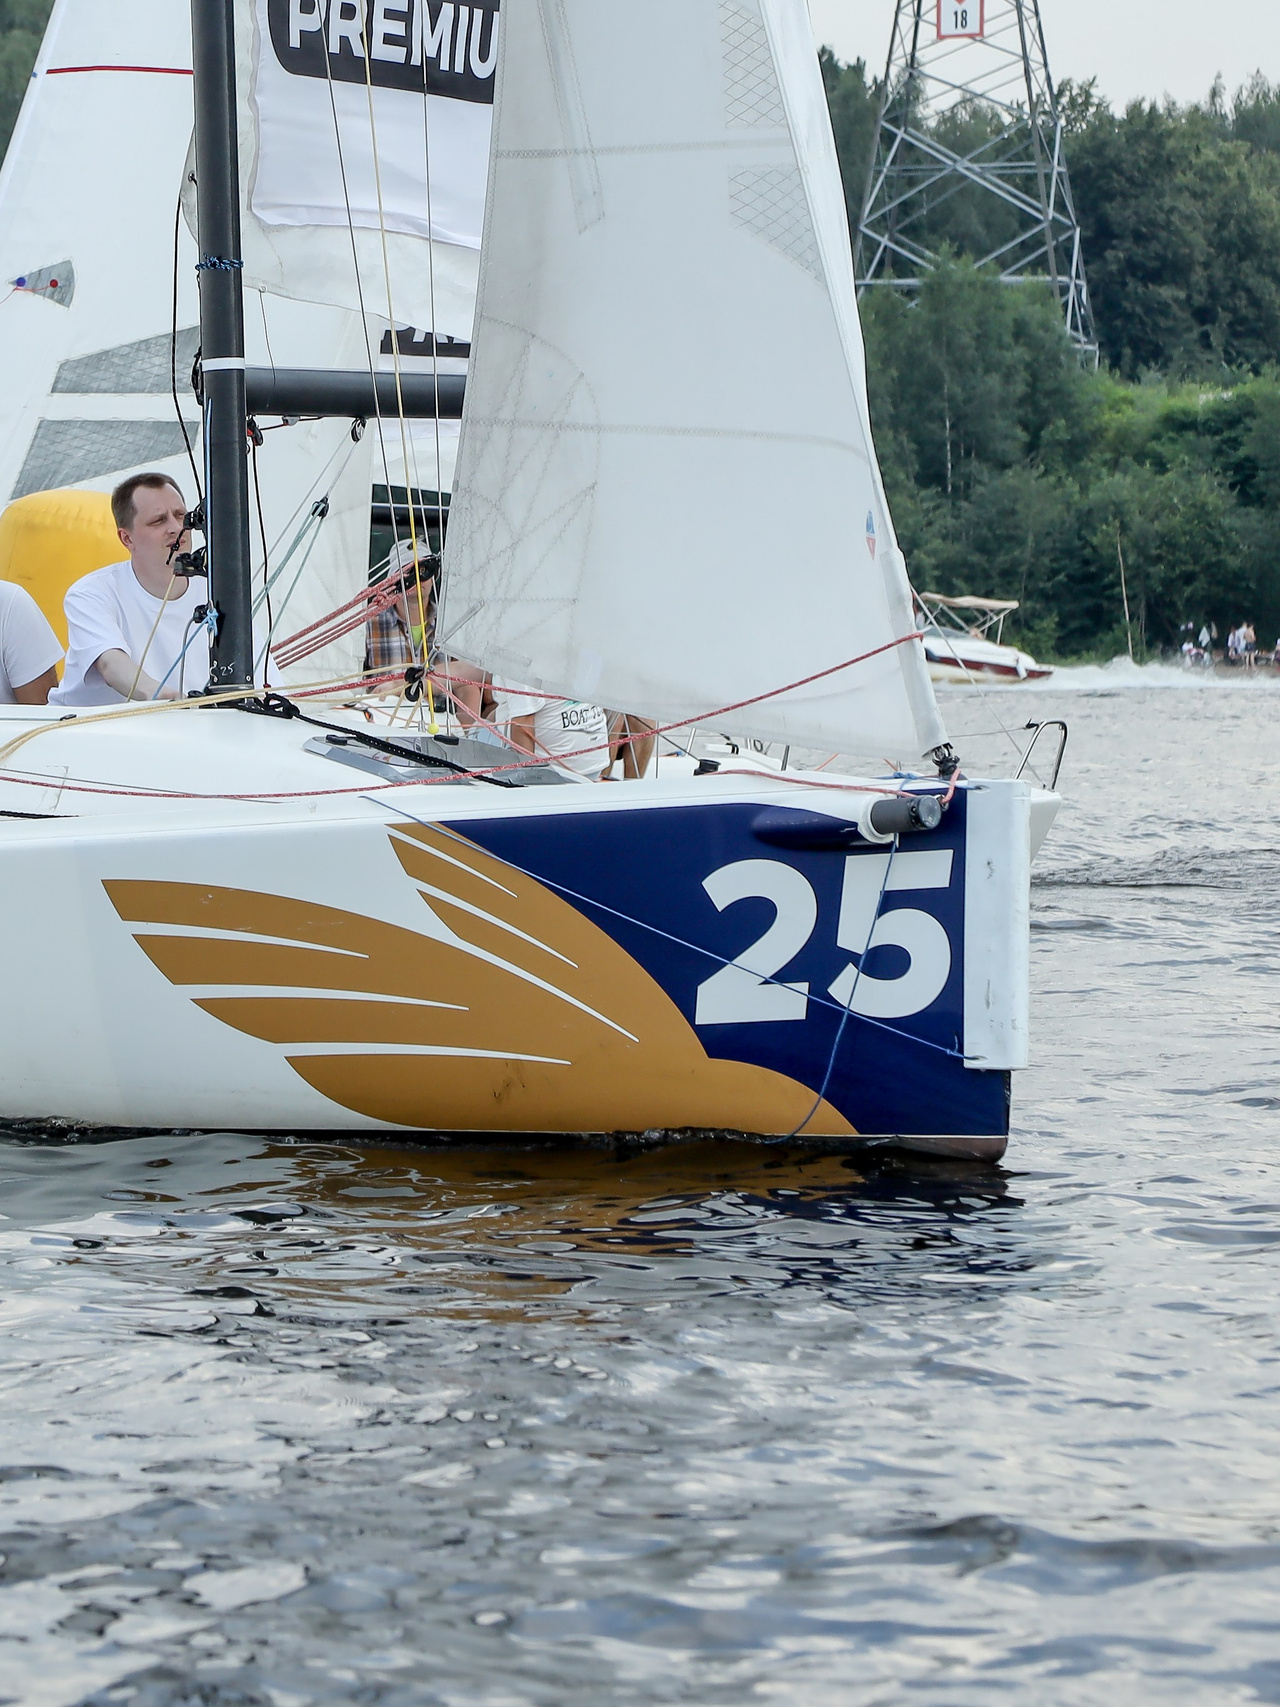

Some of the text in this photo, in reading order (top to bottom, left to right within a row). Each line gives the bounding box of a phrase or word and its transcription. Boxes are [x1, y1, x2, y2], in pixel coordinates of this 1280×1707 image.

[953, 10, 968, 29] 18
[561, 709, 589, 728] BOAT
[695, 849, 954, 1025] 25
